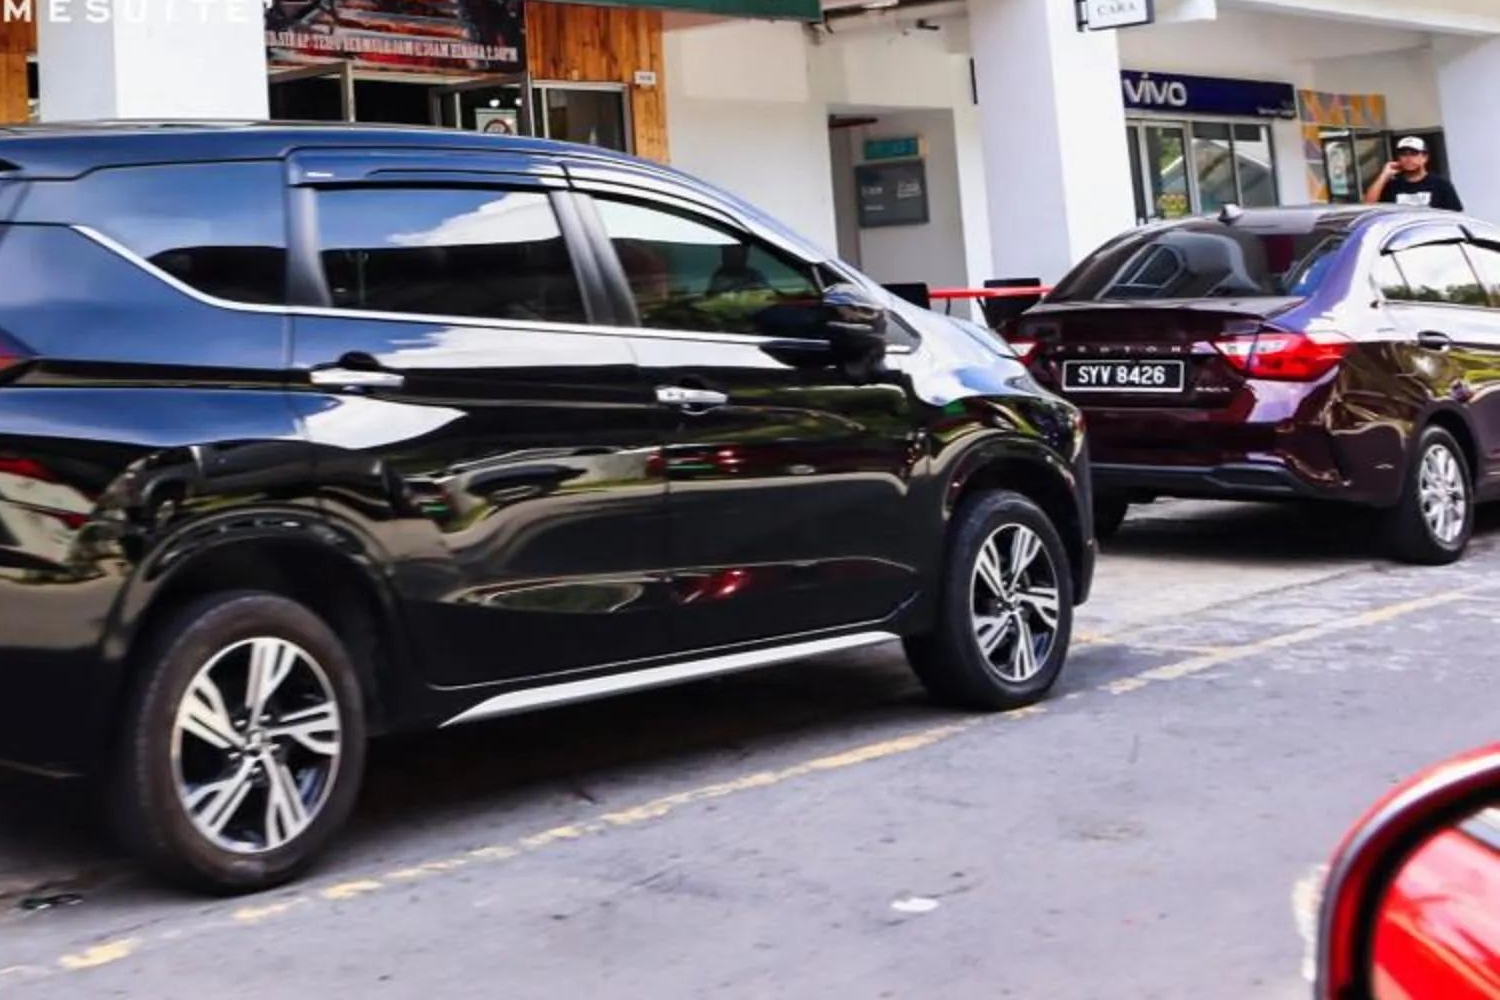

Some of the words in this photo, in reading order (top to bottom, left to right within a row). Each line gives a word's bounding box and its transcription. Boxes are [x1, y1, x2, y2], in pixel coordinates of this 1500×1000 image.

[1123, 72, 1188, 107] vivo
[1077, 365, 1112, 384] SYV
[1115, 365, 1166, 384] 8426
